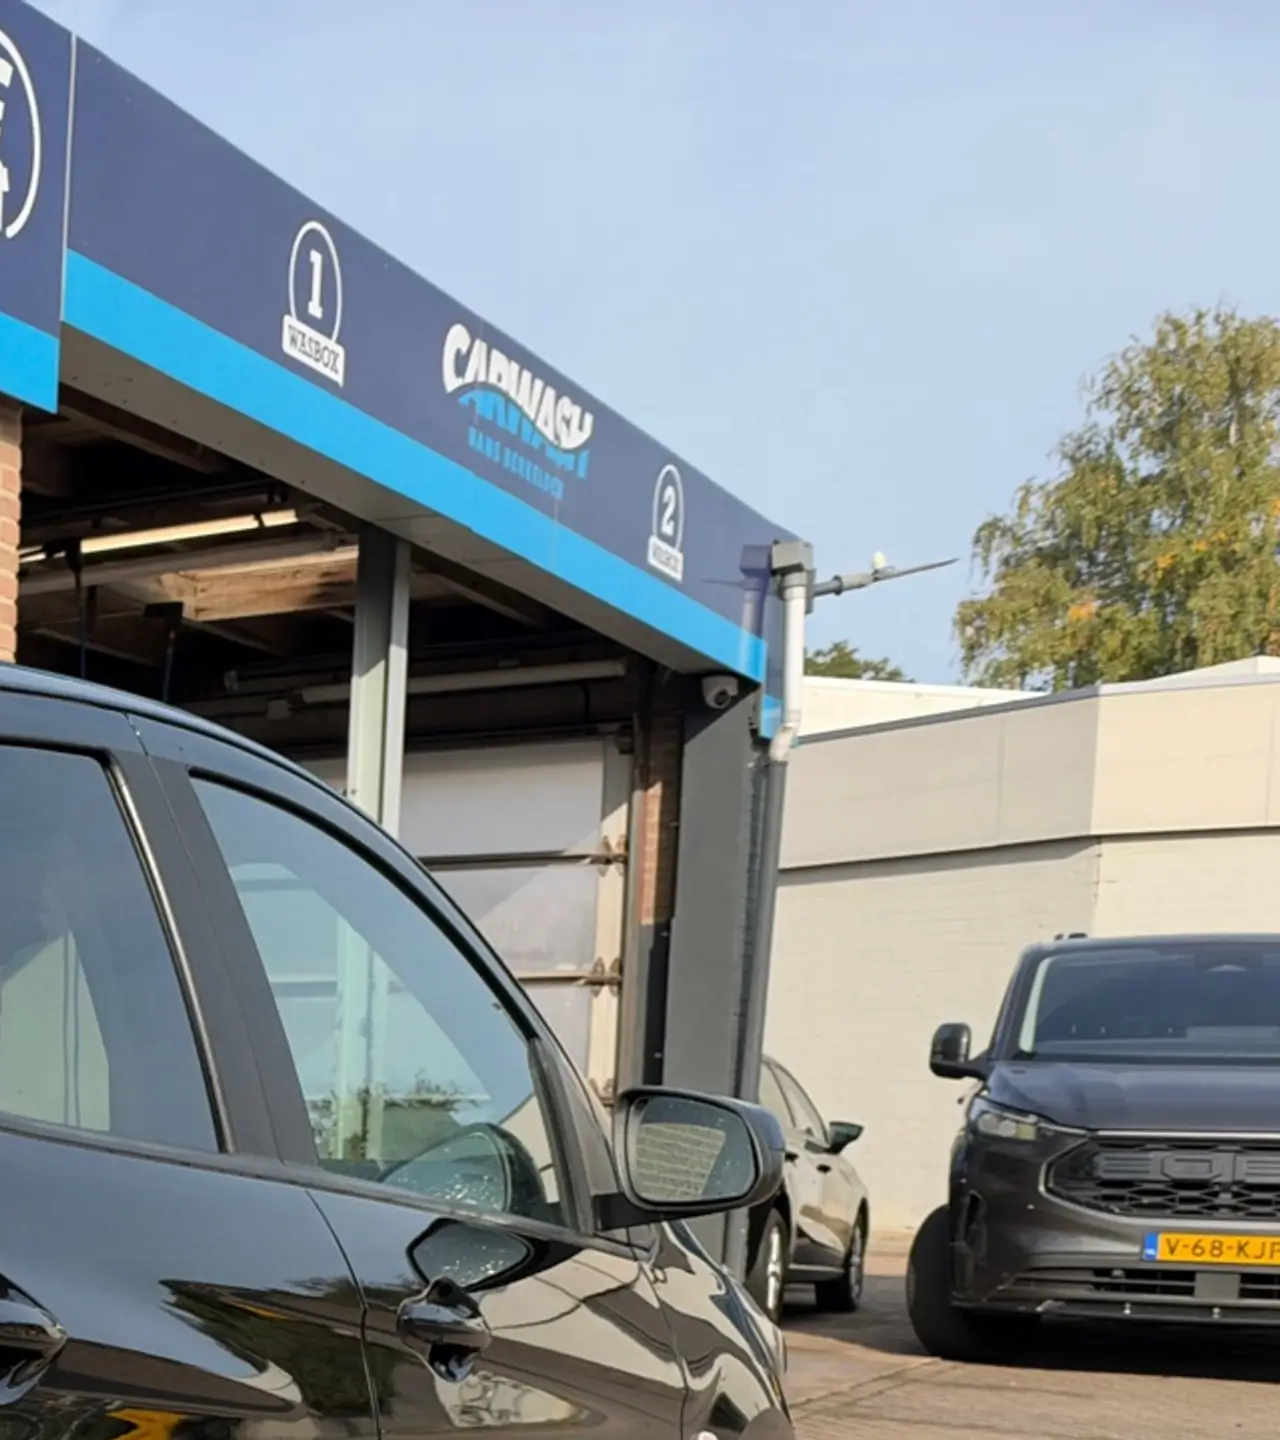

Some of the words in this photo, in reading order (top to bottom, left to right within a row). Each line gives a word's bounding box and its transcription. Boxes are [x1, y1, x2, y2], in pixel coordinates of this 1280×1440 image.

[308, 249, 323, 319] 1
[288, 324, 340, 374] WASBOX
[443, 323, 594, 449] CARWASH
[662, 485, 676, 536] 2
